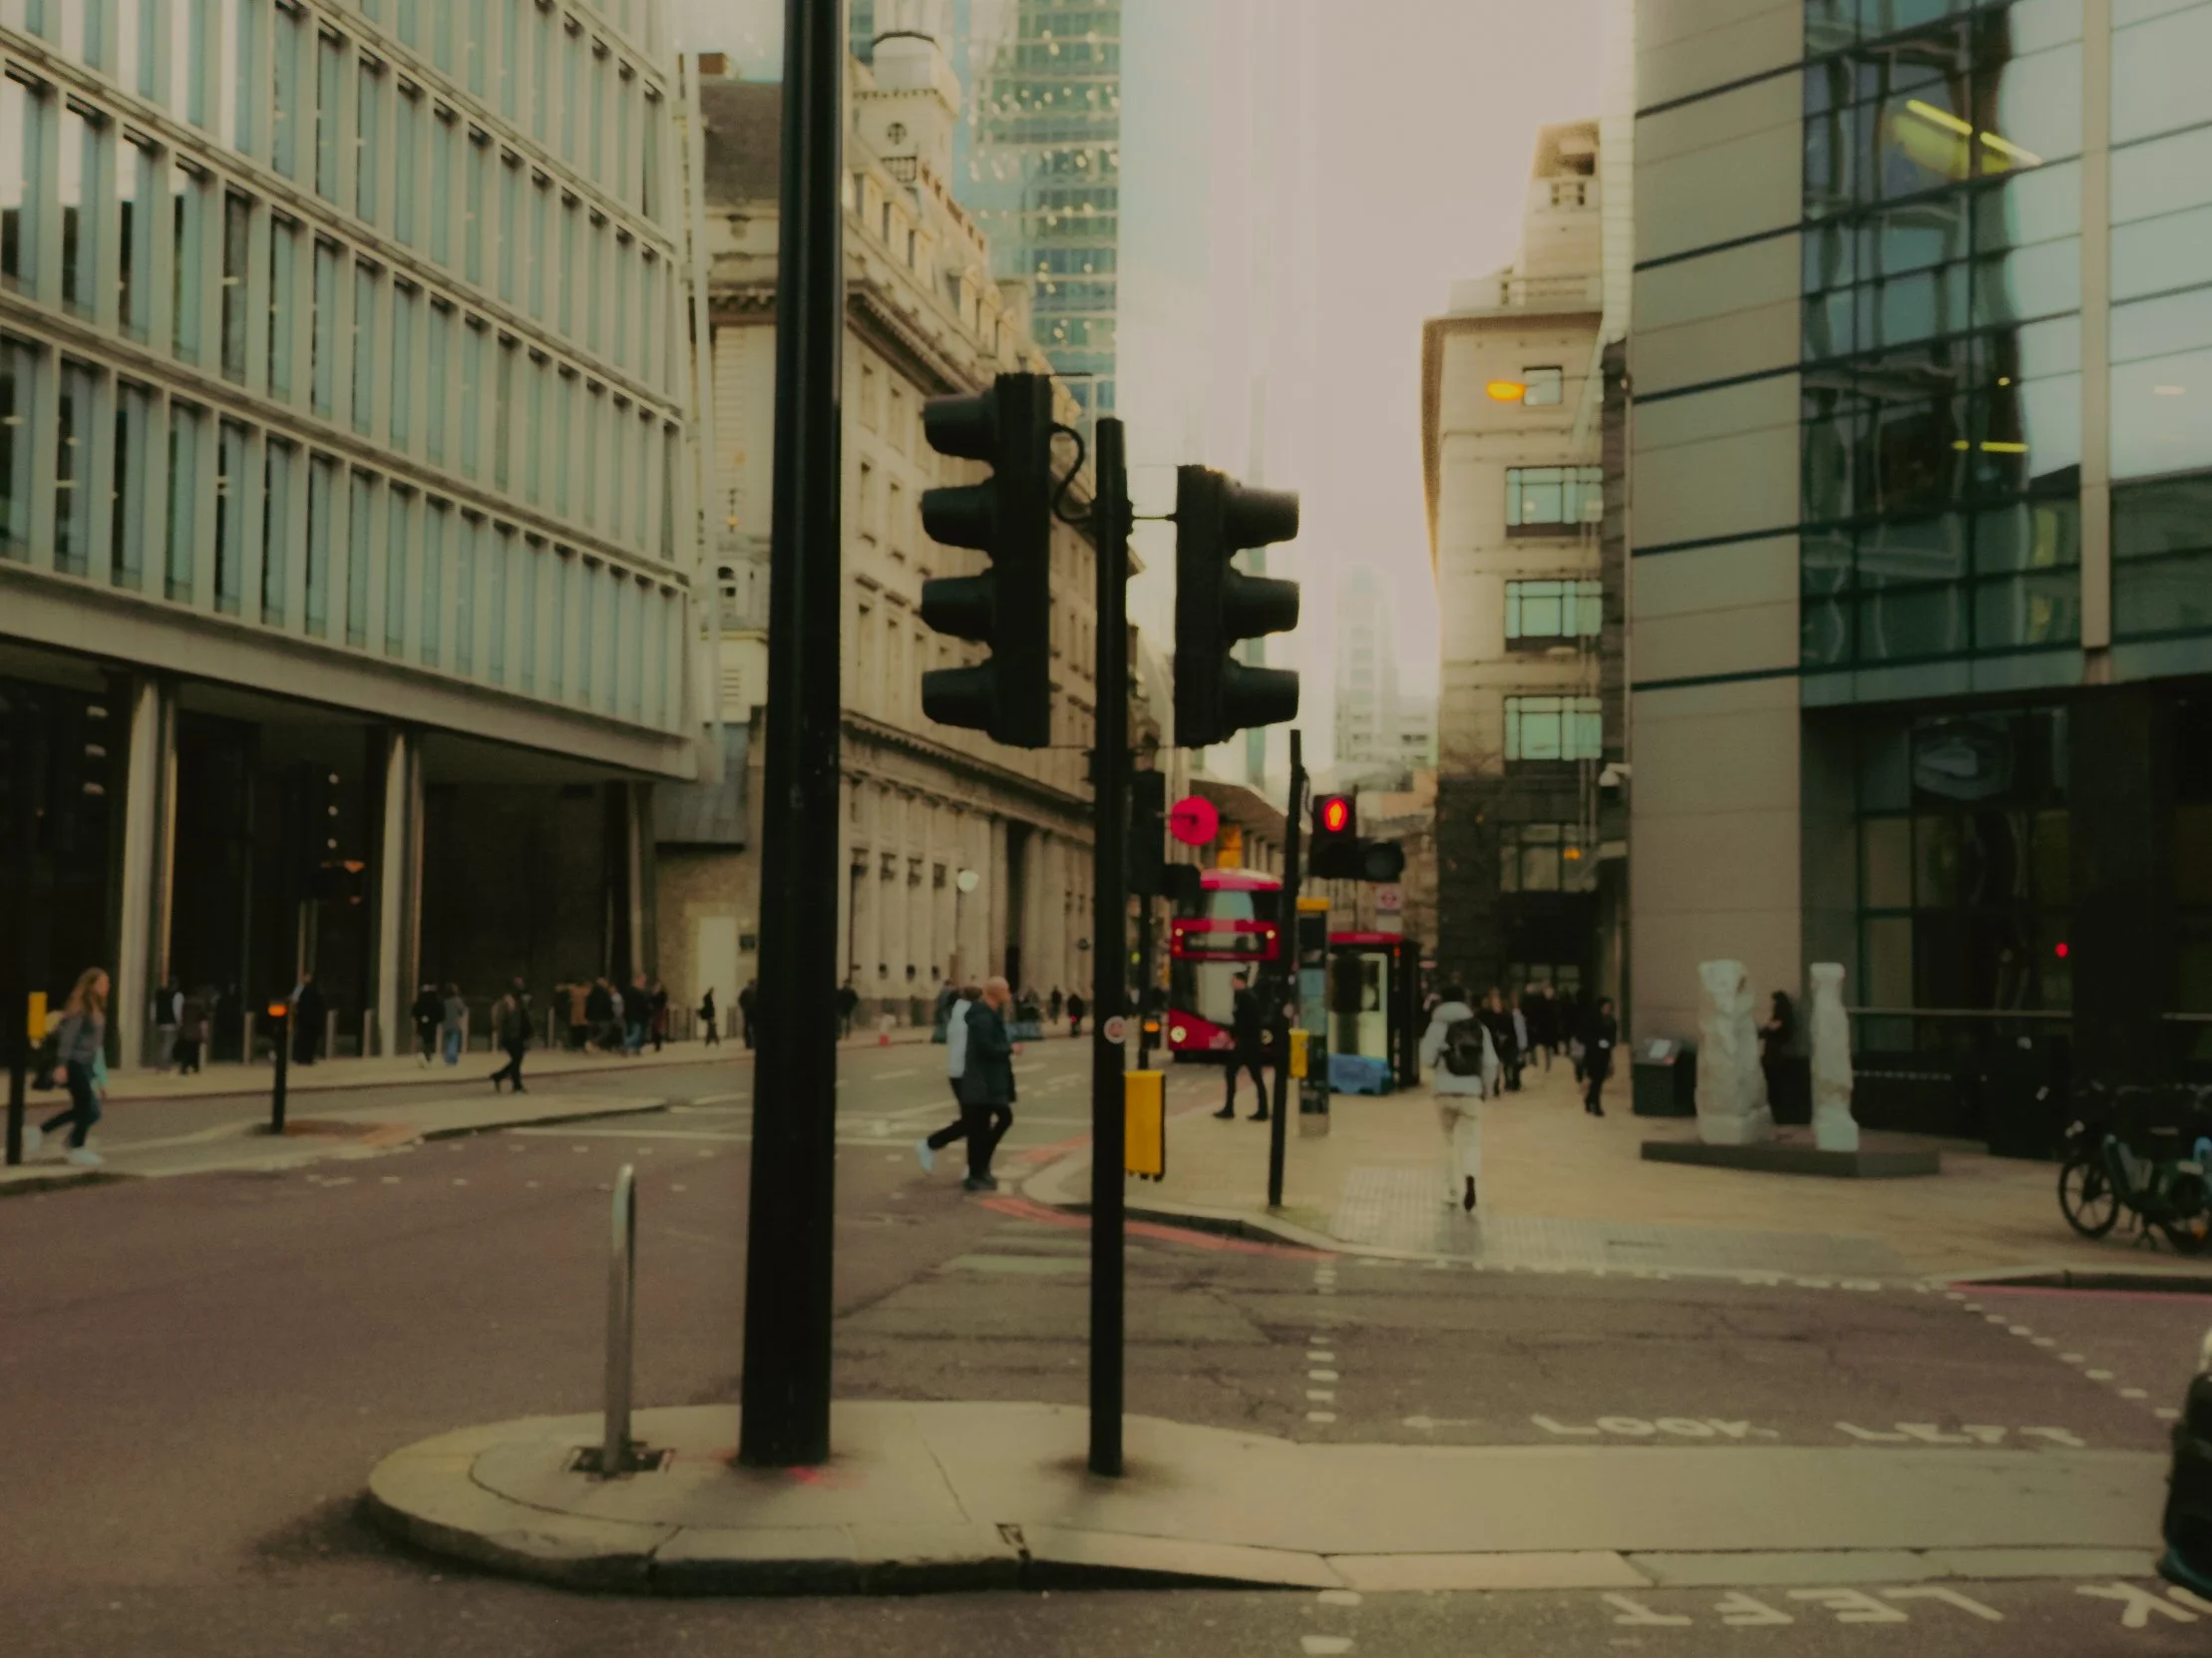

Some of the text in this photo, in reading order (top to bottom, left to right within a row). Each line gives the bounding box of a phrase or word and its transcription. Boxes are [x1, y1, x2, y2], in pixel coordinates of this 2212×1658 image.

[1531, 1413, 2086, 1448] LOOK LEFT
[1601, 1587, 2006, 1626] LEFT
